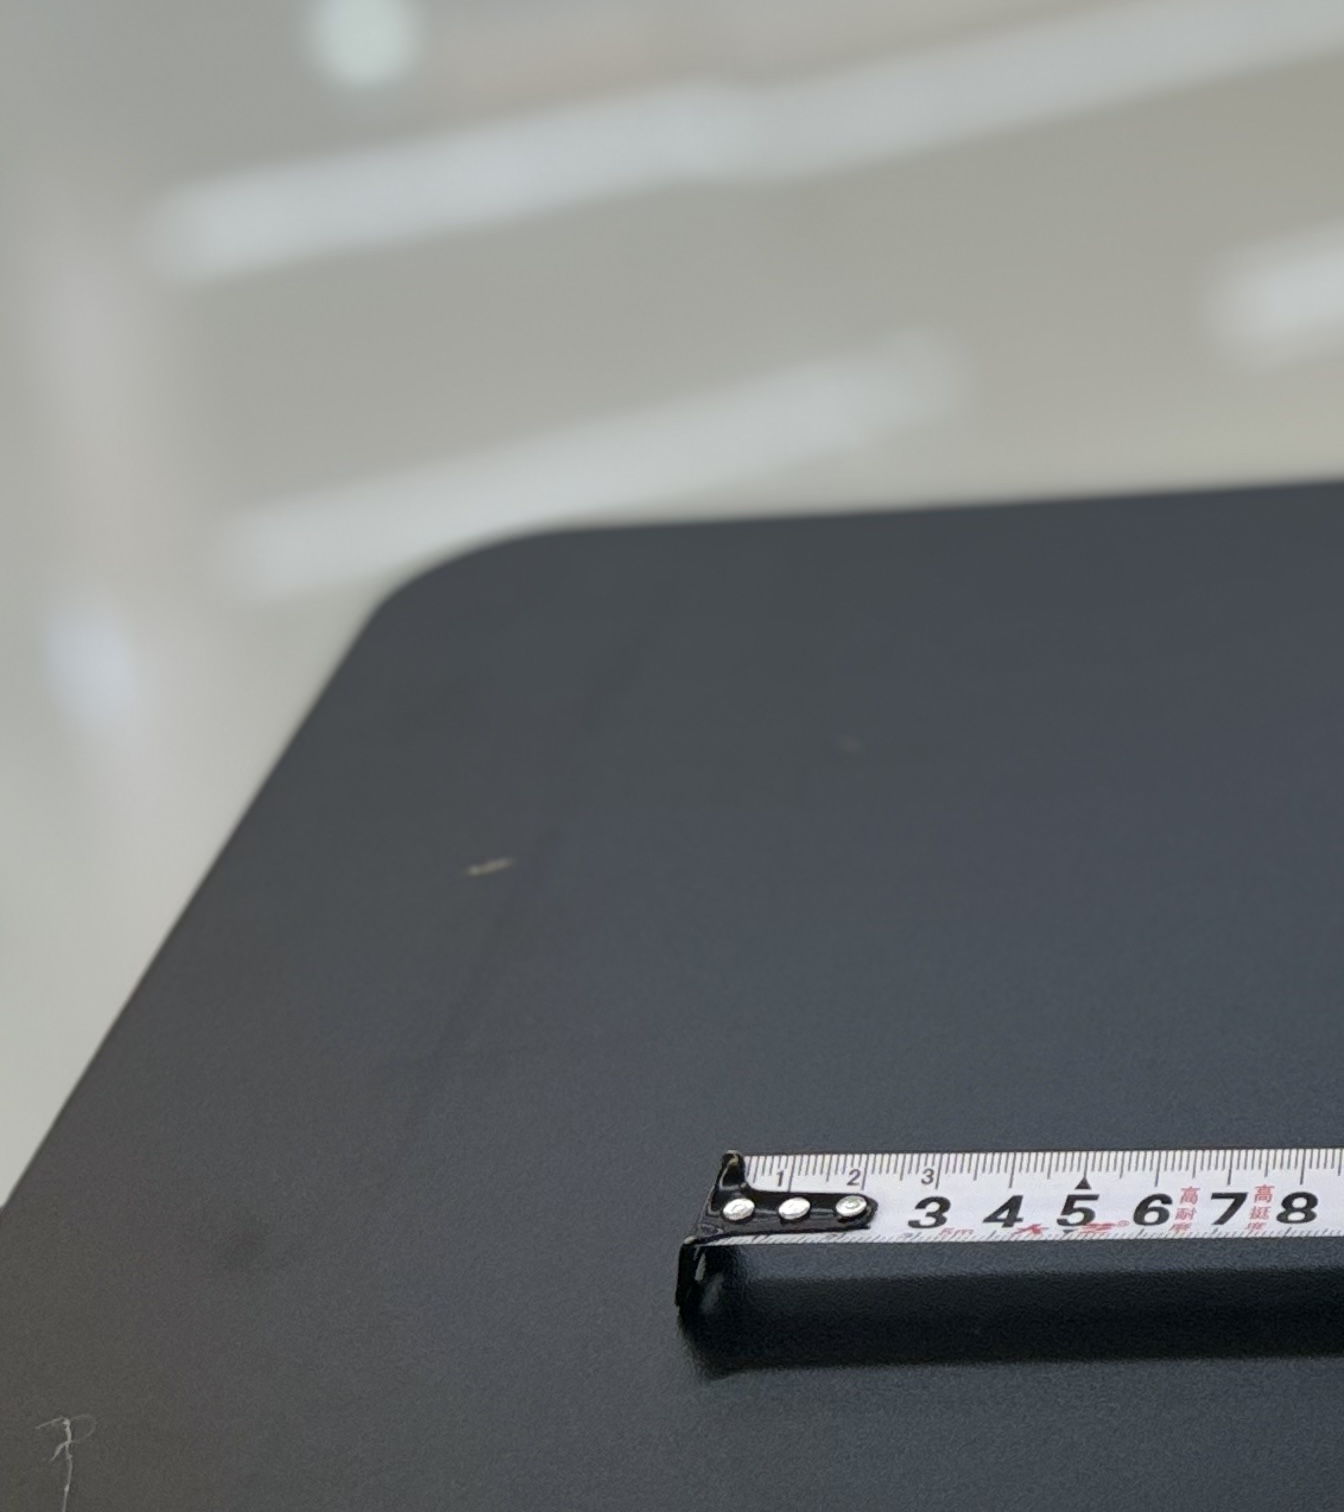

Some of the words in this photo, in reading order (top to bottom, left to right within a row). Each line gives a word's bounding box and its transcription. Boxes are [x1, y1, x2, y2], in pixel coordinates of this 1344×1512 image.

[846, 1169, 861, 1186] 2
[921, 1168, 934, 1185] 3
[908, 1196, 952, 1229] 3
[983, 1195, 1023, 1228] 4
[1056, 1194, 1100, 1226] 5
[1133, 1193, 1174, 1226] 6
[1210, 1192, 1248, 1225] 7
[1276, 1191, 1318, 1224] 8
